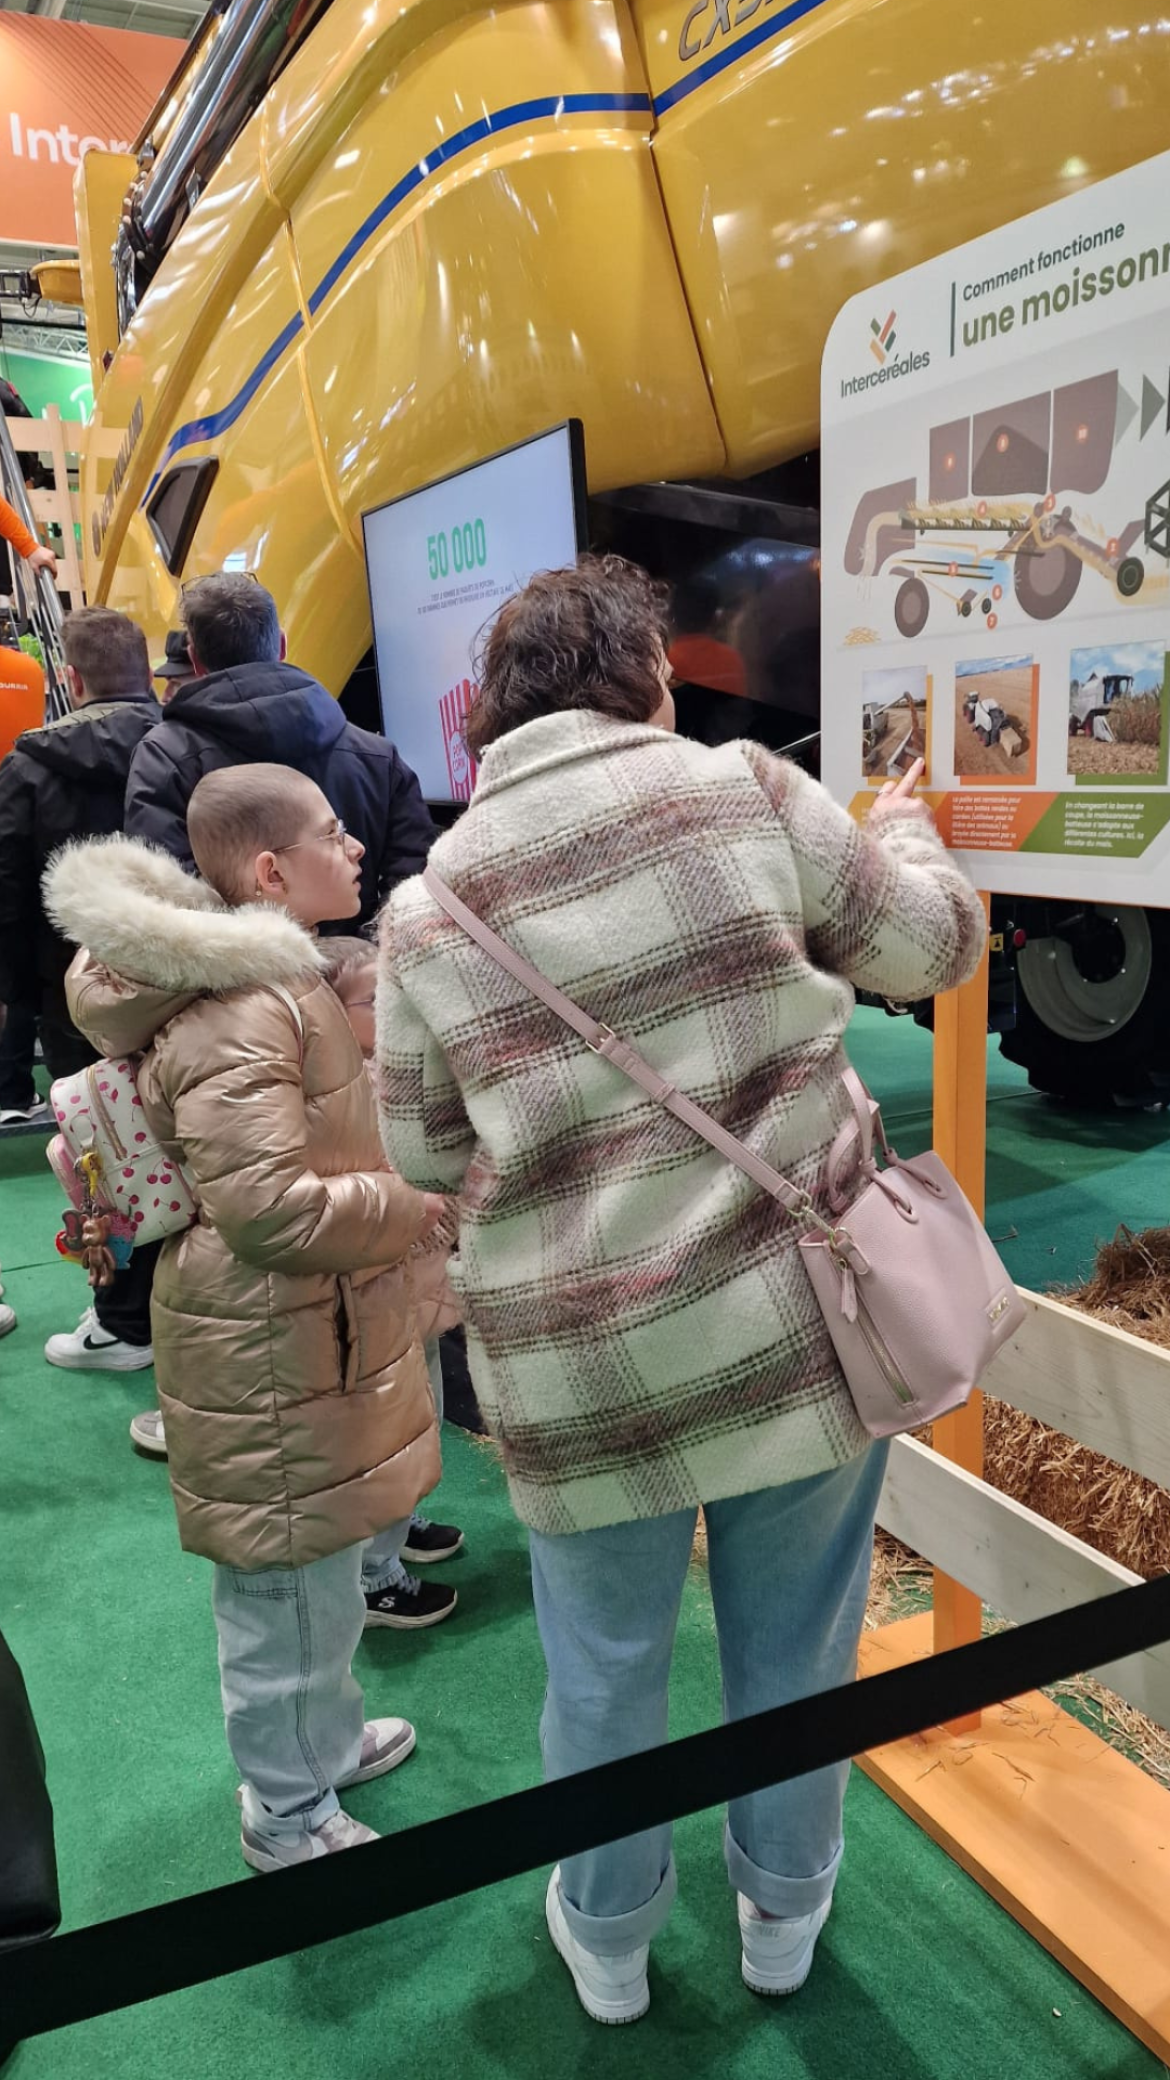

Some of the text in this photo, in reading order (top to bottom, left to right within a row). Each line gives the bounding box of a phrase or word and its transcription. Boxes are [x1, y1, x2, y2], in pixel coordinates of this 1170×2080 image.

[679, 0, 773, 62] CX
[9, 112, 132, 166] Int
[963, 222, 1125, 302] Comment fonctionne
[963, 305, 1015, 348] une
[427, 518, 487, 580] 50 000
[1074, 801, 1107, 812] changeant
[1116, 802, 1134, 810] barre
[1135, 802, 1144, 811] de
[759, 1925, 781, 1938] NIKE
